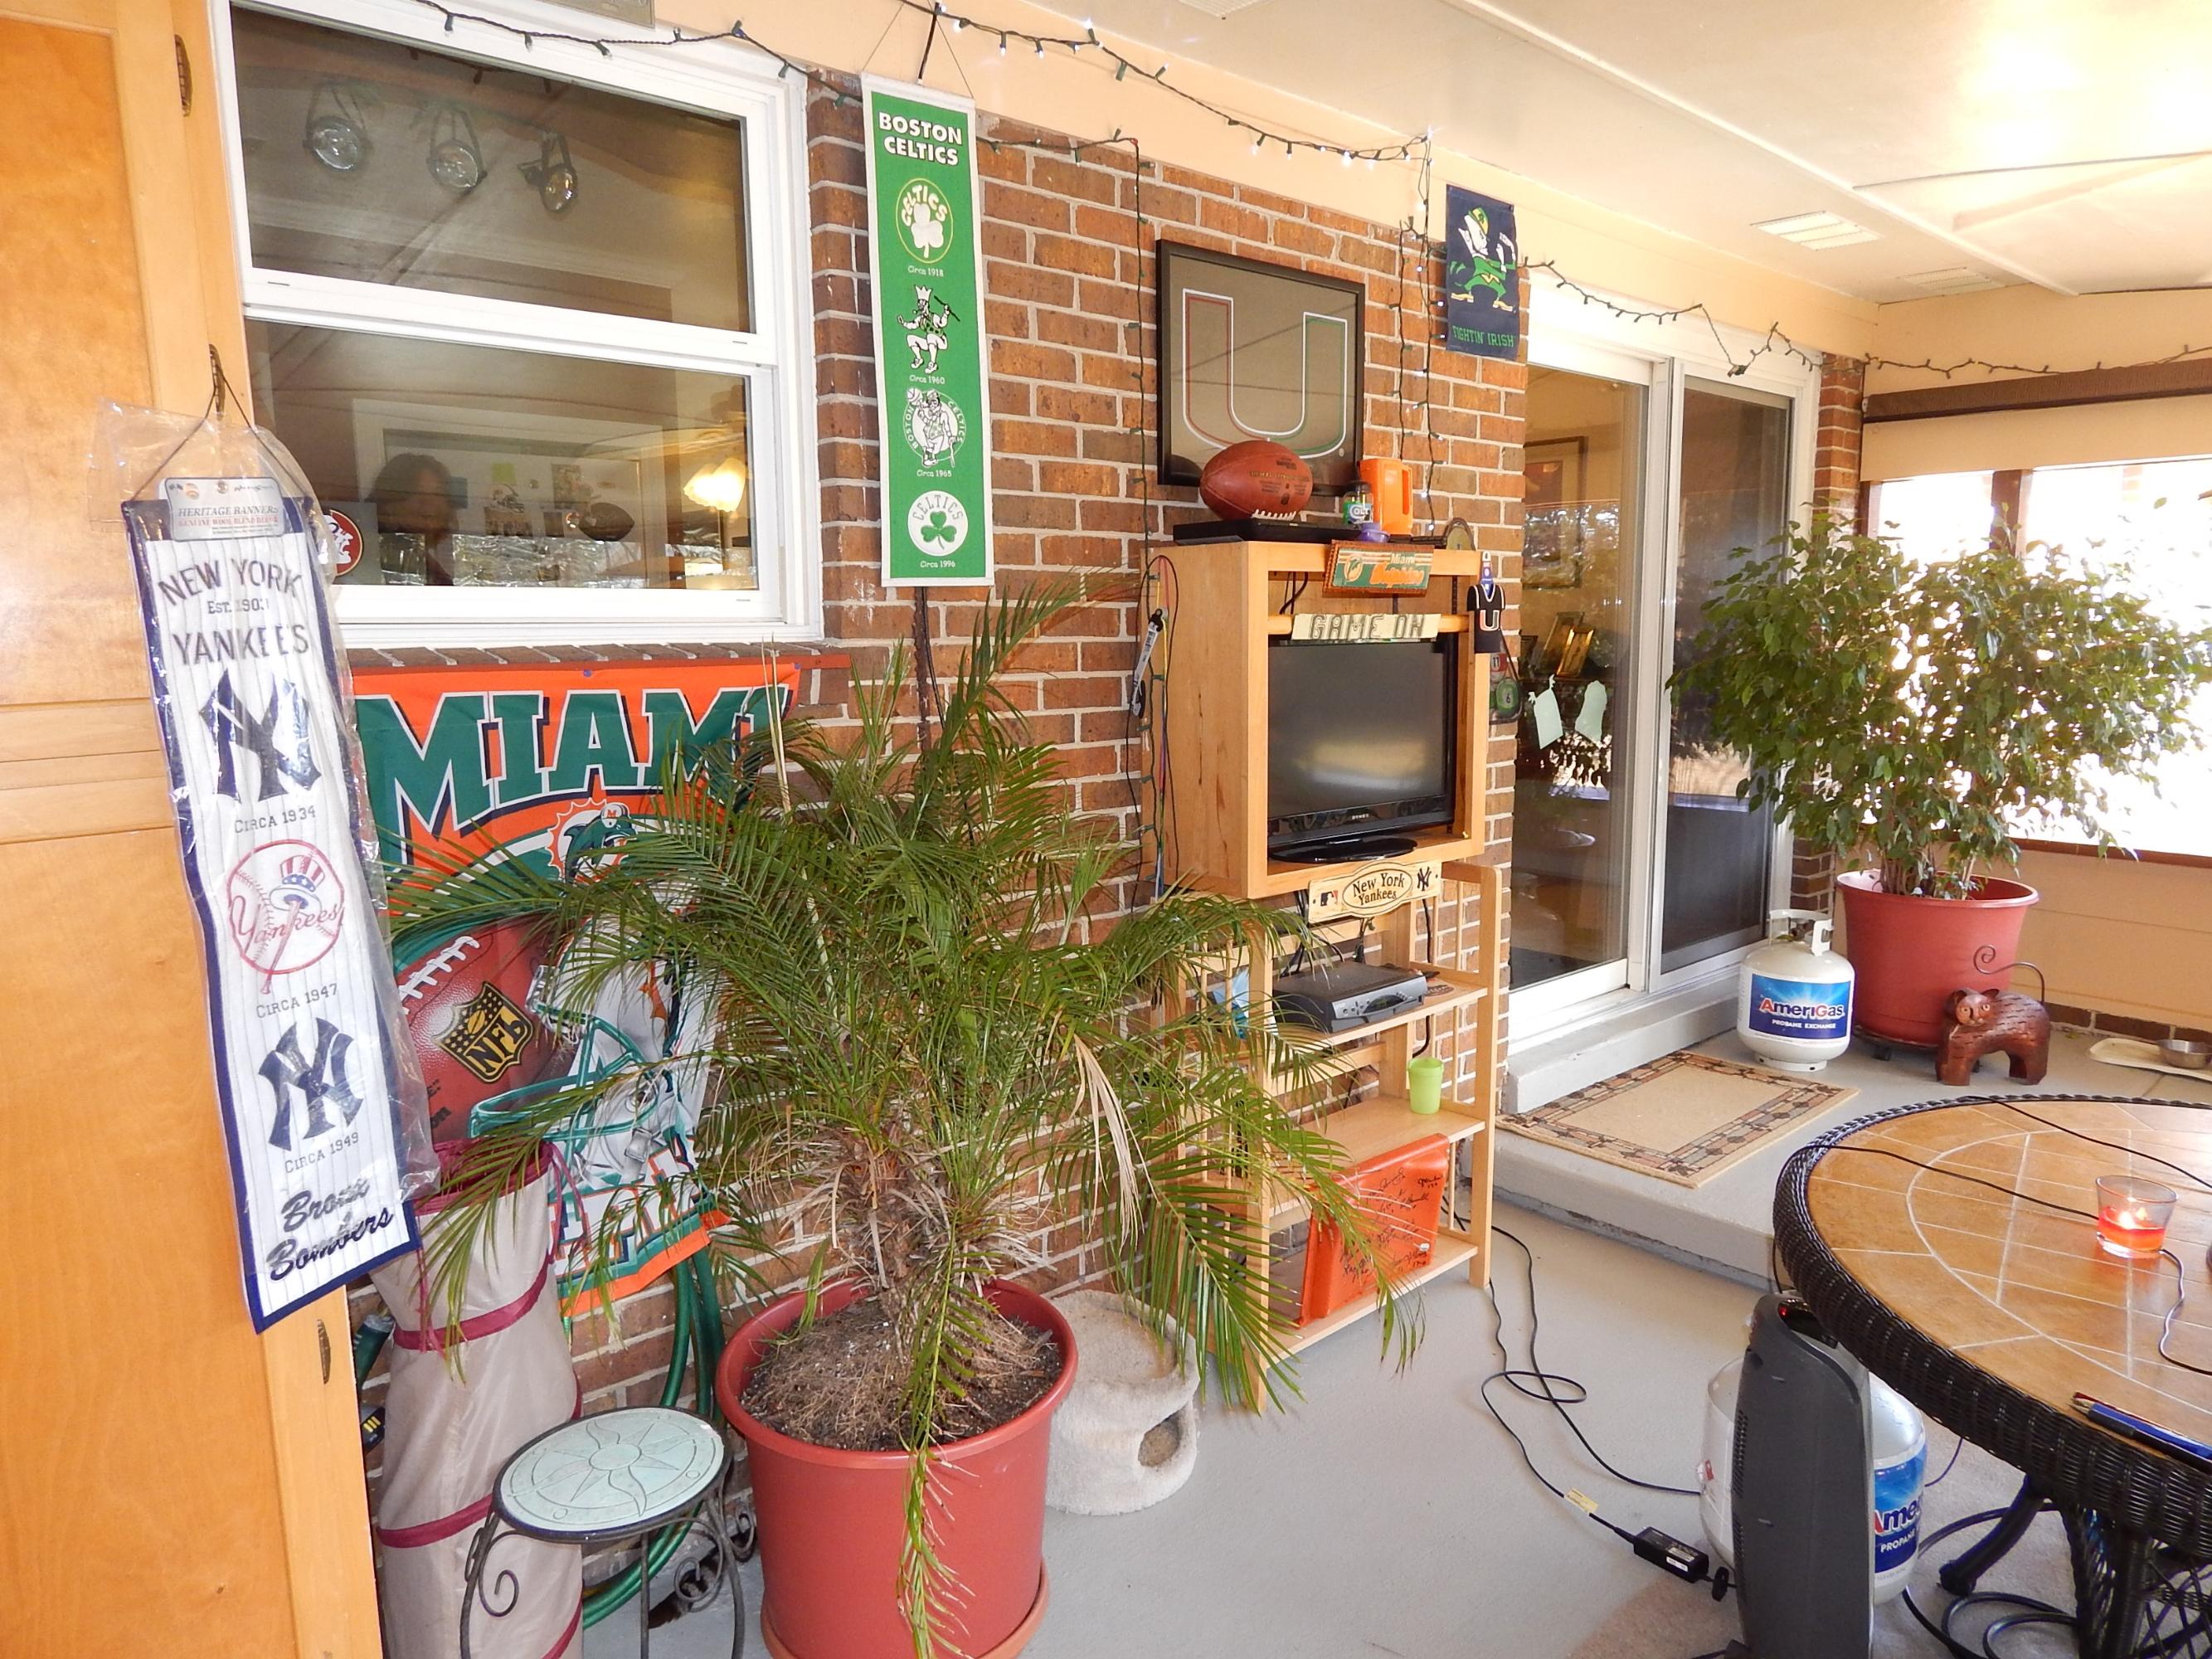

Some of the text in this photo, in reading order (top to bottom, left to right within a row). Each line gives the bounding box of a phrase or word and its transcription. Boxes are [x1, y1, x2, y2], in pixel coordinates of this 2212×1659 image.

[878, 111, 962, 145] BOSTON
[883, 136, 959, 166] CELTICS
[902, 184, 948, 226] CELTICS
[907, 265, 944, 277] Circa 1918
[1488, 333, 1514, 347] IRISH
[909, 374, 946, 385] Circa 1960
[1183, 288, 1348, 459] U
[905, 401, 965, 449] BOSTON CELTICS
[178, 505, 280, 517] HERITAGE BANNERS
[912, 494, 964, 521] CELTICS
[1390, 553, 1416, 564] Miami
[158, 558, 303, 606] NEW YORK
[1310, 614, 1384, 640] GAME
[1480, 609, 1500, 631] U
[173, 625, 309, 666] YANKEES
[235, 805, 316, 834] CIRCA 1934
[1353, 873, 1405, 897] New York
[1359, 888, 1397, 906] Yankees
[231, 895, 344, 954] Yankees
[255, 983, 338, 1019] CIRCA 1947
[1759, 998, 1844, 1019] AmeriGas
[465, 1007, 527, 1074] NFL
[284, 1131, 359, 1174] CIRCA 1949
